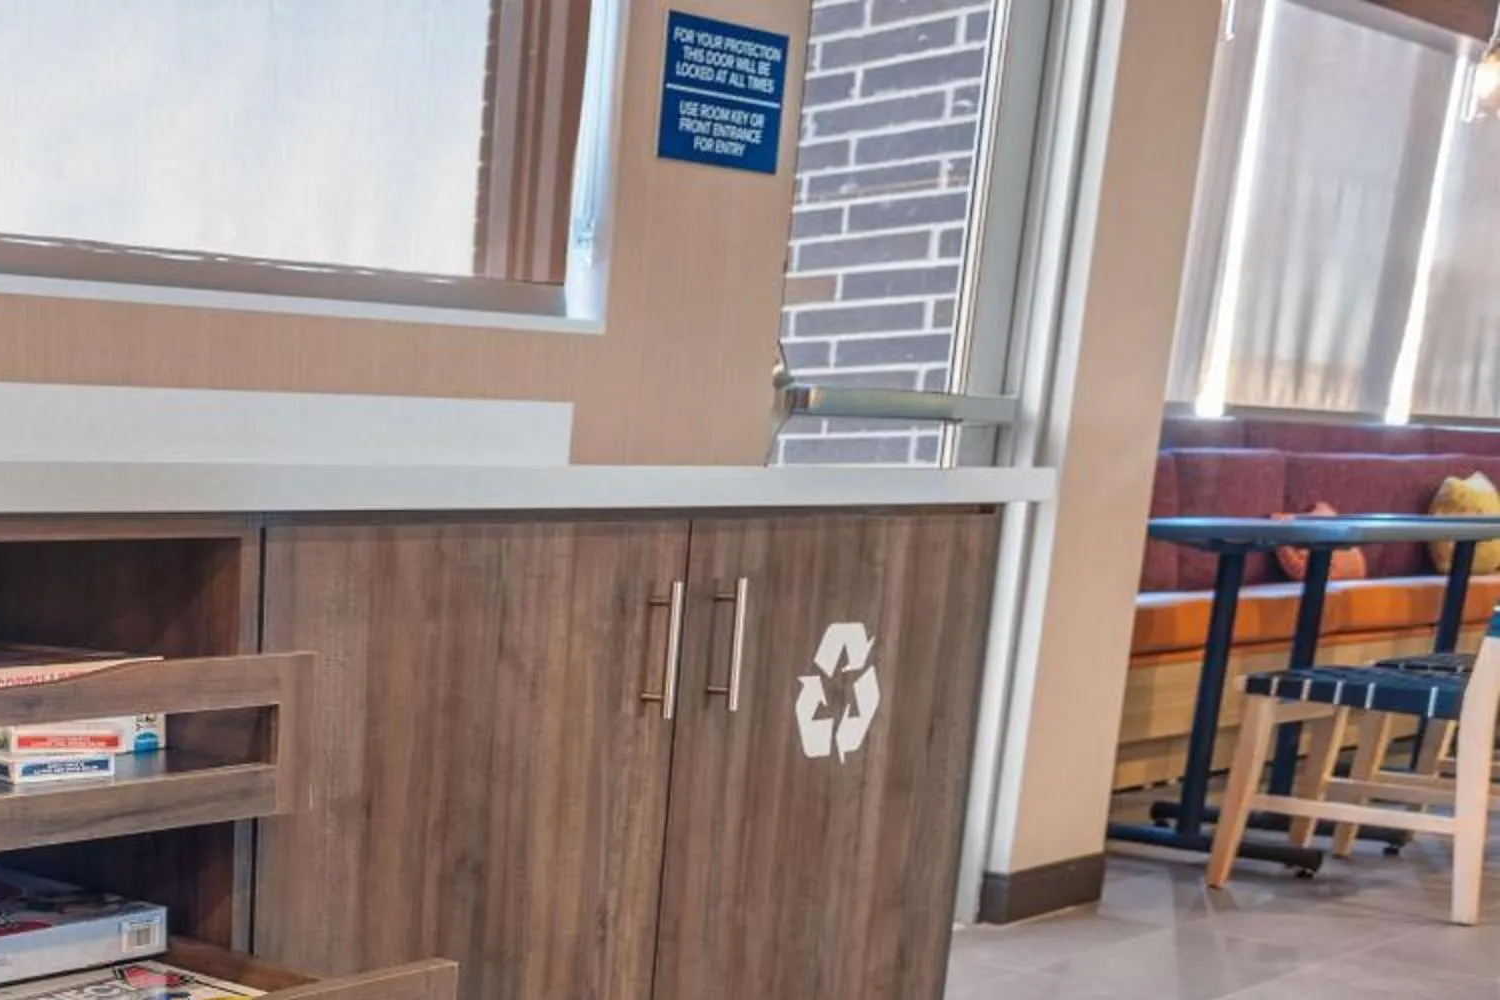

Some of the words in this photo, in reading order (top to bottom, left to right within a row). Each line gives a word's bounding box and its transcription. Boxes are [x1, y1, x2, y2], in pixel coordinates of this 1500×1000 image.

[674, 27, 694, 43] FOR
[698, 32, 723, 48] YOUR
[724, 37, 781, 61] PROTECTION
[683, 46, 704, 63] THIS
[706, 50, 734, 67] DOOR
[736, 55, 756, 73] WILL
[758, 61, 771, 76] BE
[675, 62, 714, 81] LOCKED
[715, 69, 728, 83] AT
[729, 73, 746, 88] ALL
[748, 76, 775, 93] TIMES
[679, 100, 698, 116] USE
[700, 104, 730, 120] ROOM
[731, 110, 750, 124] KEY
[750, 113, 765, 128] OR
[678, 117, 711, 134] FRONT
[712, 124, 762, 144] ENTRANCE
[693, 136, 714, 151] FOR
[716, 140, 745, 157] ENTRY
